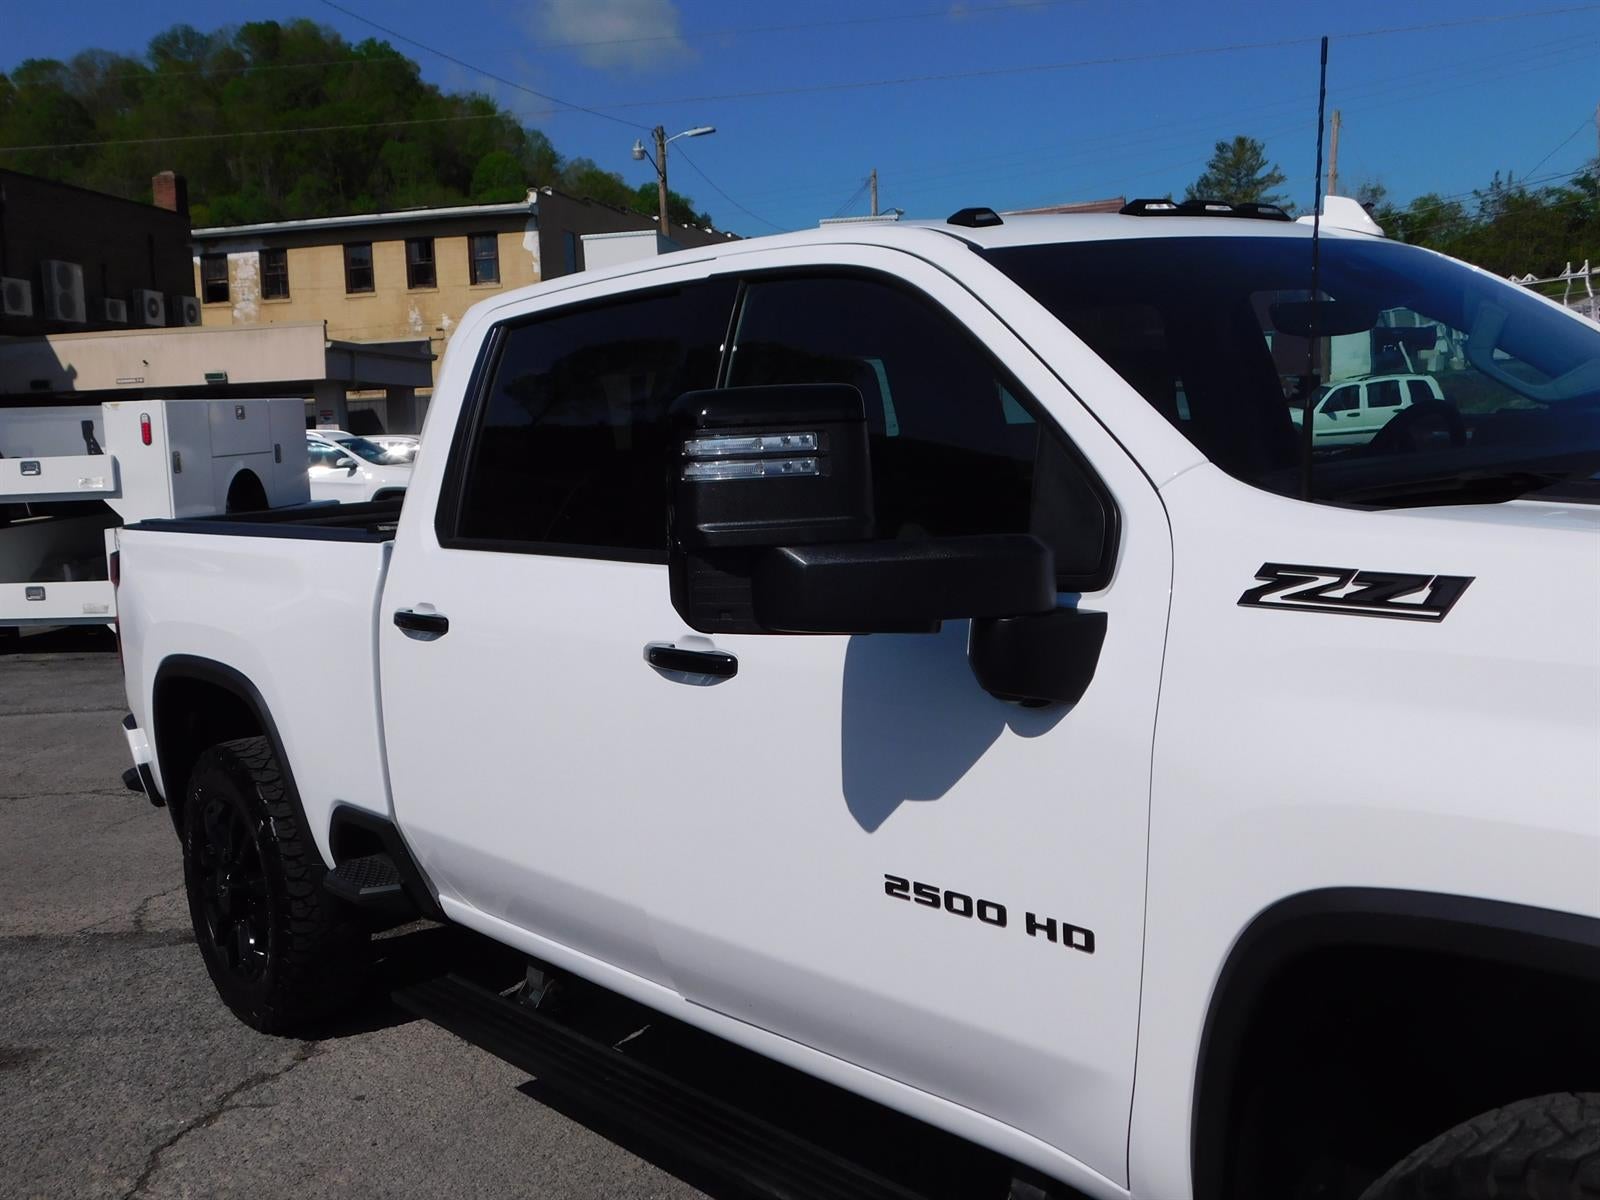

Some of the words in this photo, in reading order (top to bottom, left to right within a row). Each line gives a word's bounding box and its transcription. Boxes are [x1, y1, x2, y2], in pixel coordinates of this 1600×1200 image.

[1237, 562, 1476, 623] Z71
[884, 873, 1007, 928] 2500
[1025, 911, 1096, 955] HD
